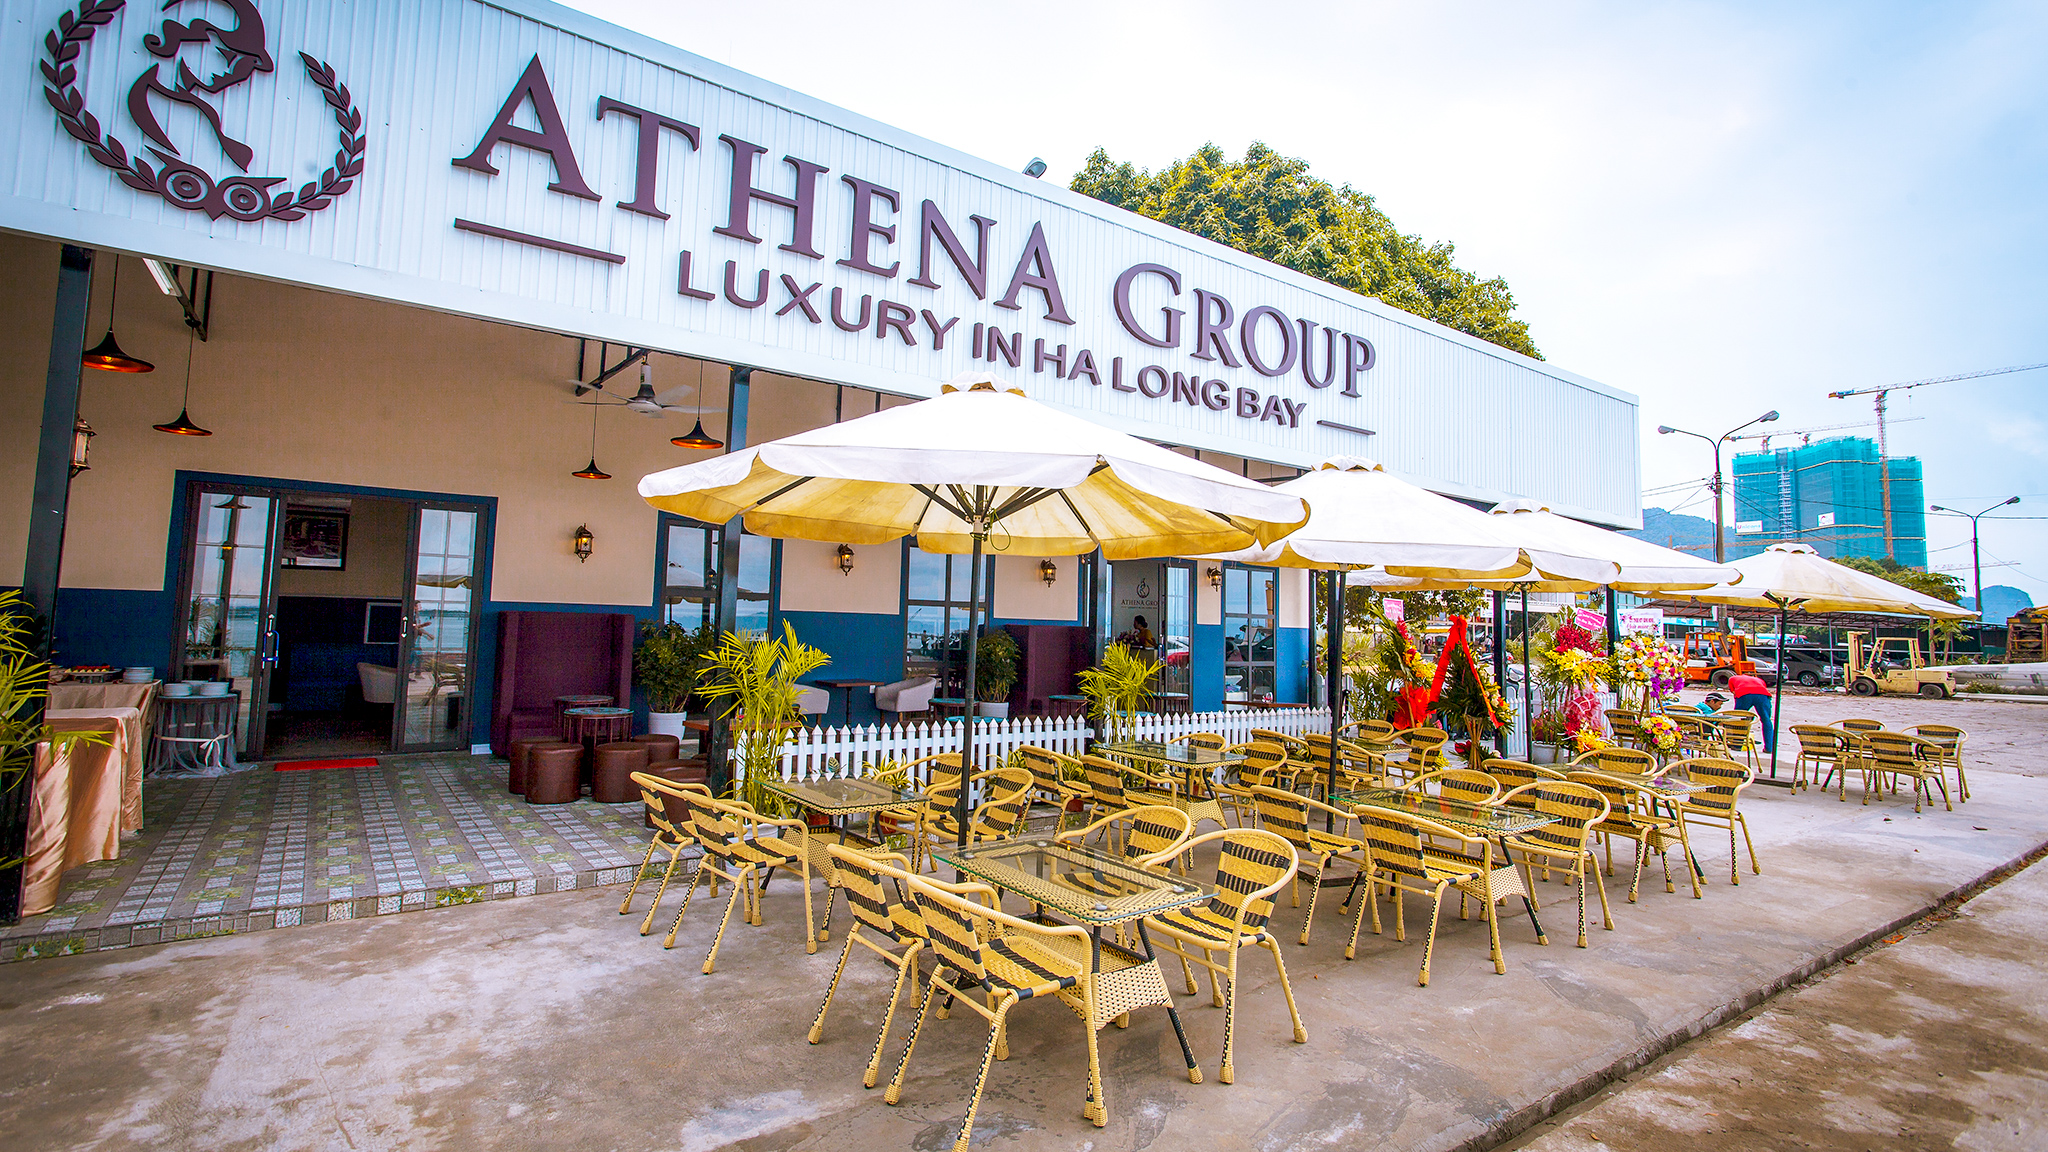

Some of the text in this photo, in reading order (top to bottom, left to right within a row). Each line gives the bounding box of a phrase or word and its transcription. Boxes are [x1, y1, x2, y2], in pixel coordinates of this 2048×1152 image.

[451, 52, 1376, 398] ATHENA GROUP
[677, 250, 1307, 429] LUXURY IN HA LONG BAY
